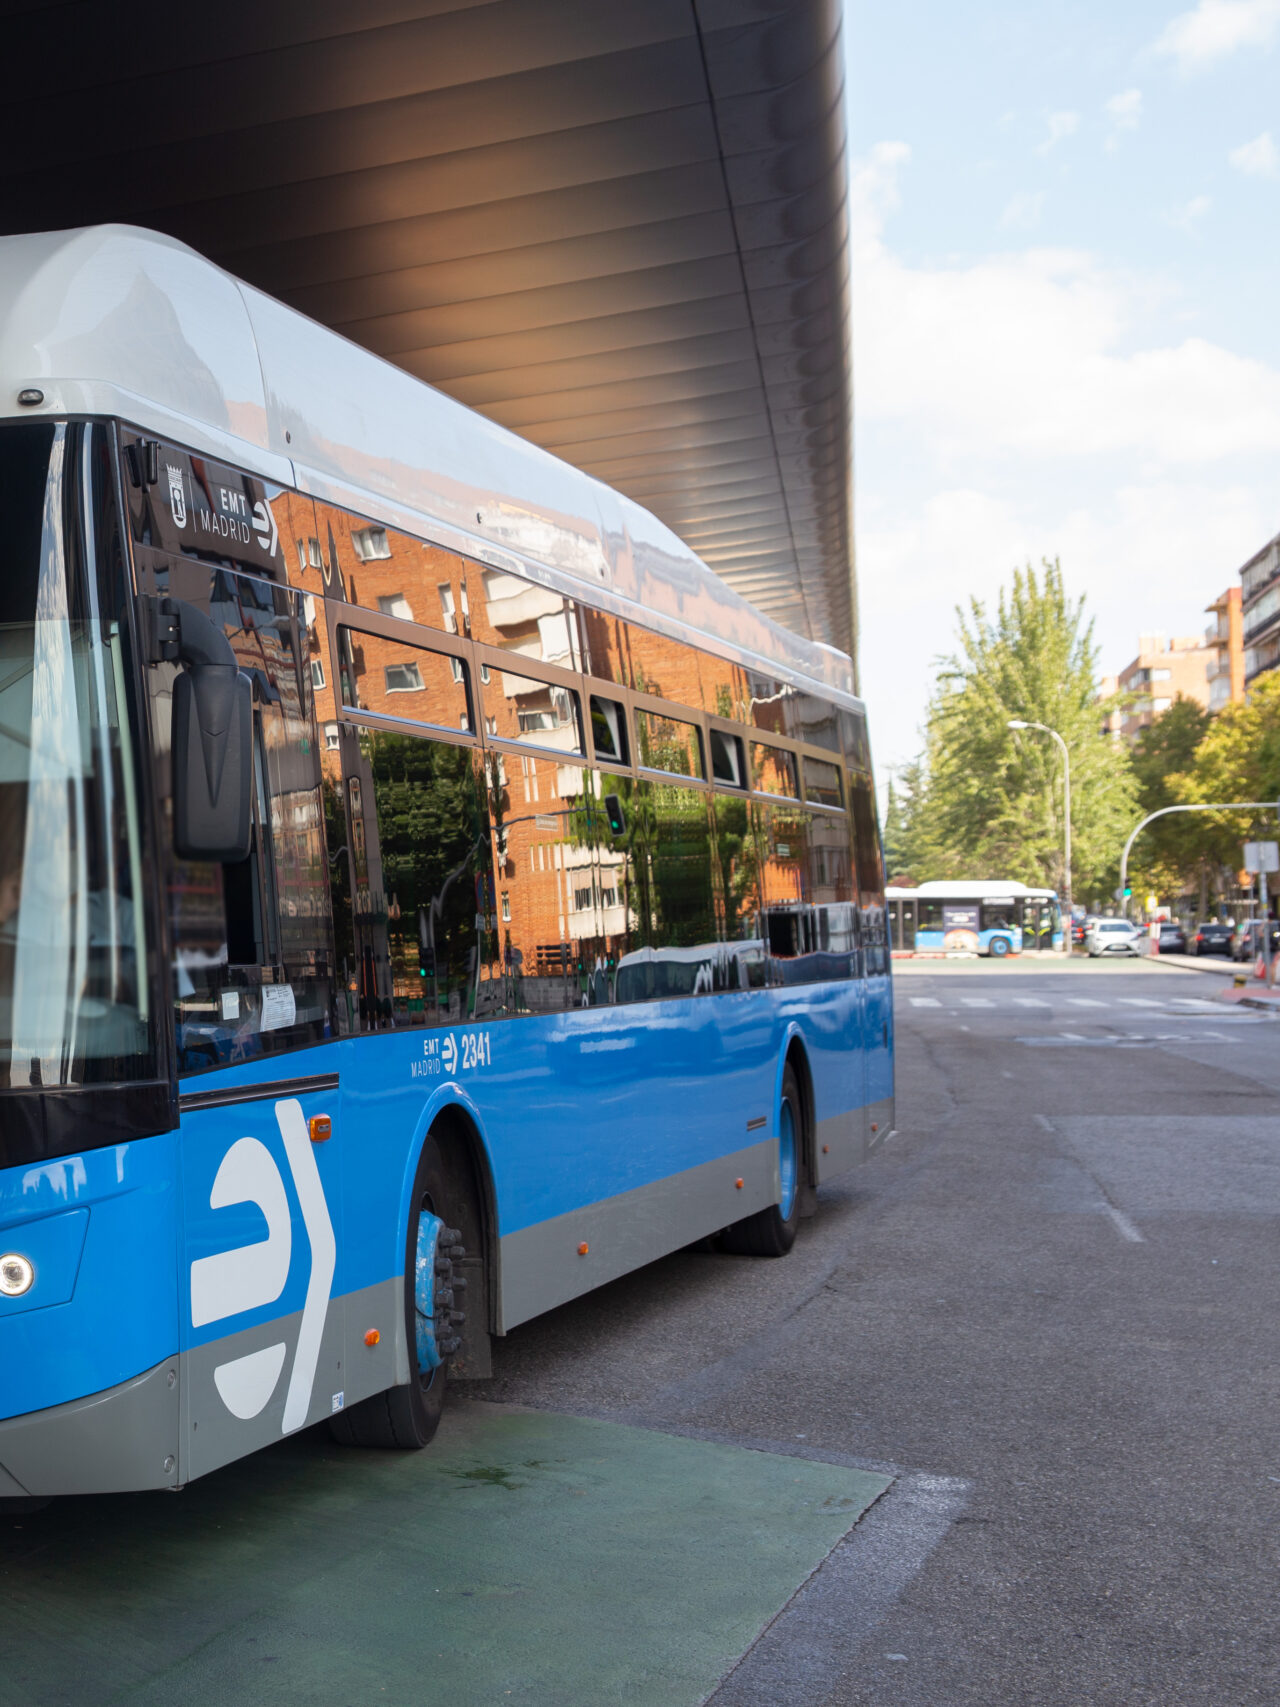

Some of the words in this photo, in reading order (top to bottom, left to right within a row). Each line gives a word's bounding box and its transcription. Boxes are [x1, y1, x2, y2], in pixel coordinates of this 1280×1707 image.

[220, 488, 246, 517] EMT
[200, 508, 250, 544] MADRID
[423, 1038, 440, 1056] EMT
[461, 1031, 491, 1069] 2341
[411, 1058, 441, 1078] MADRID
